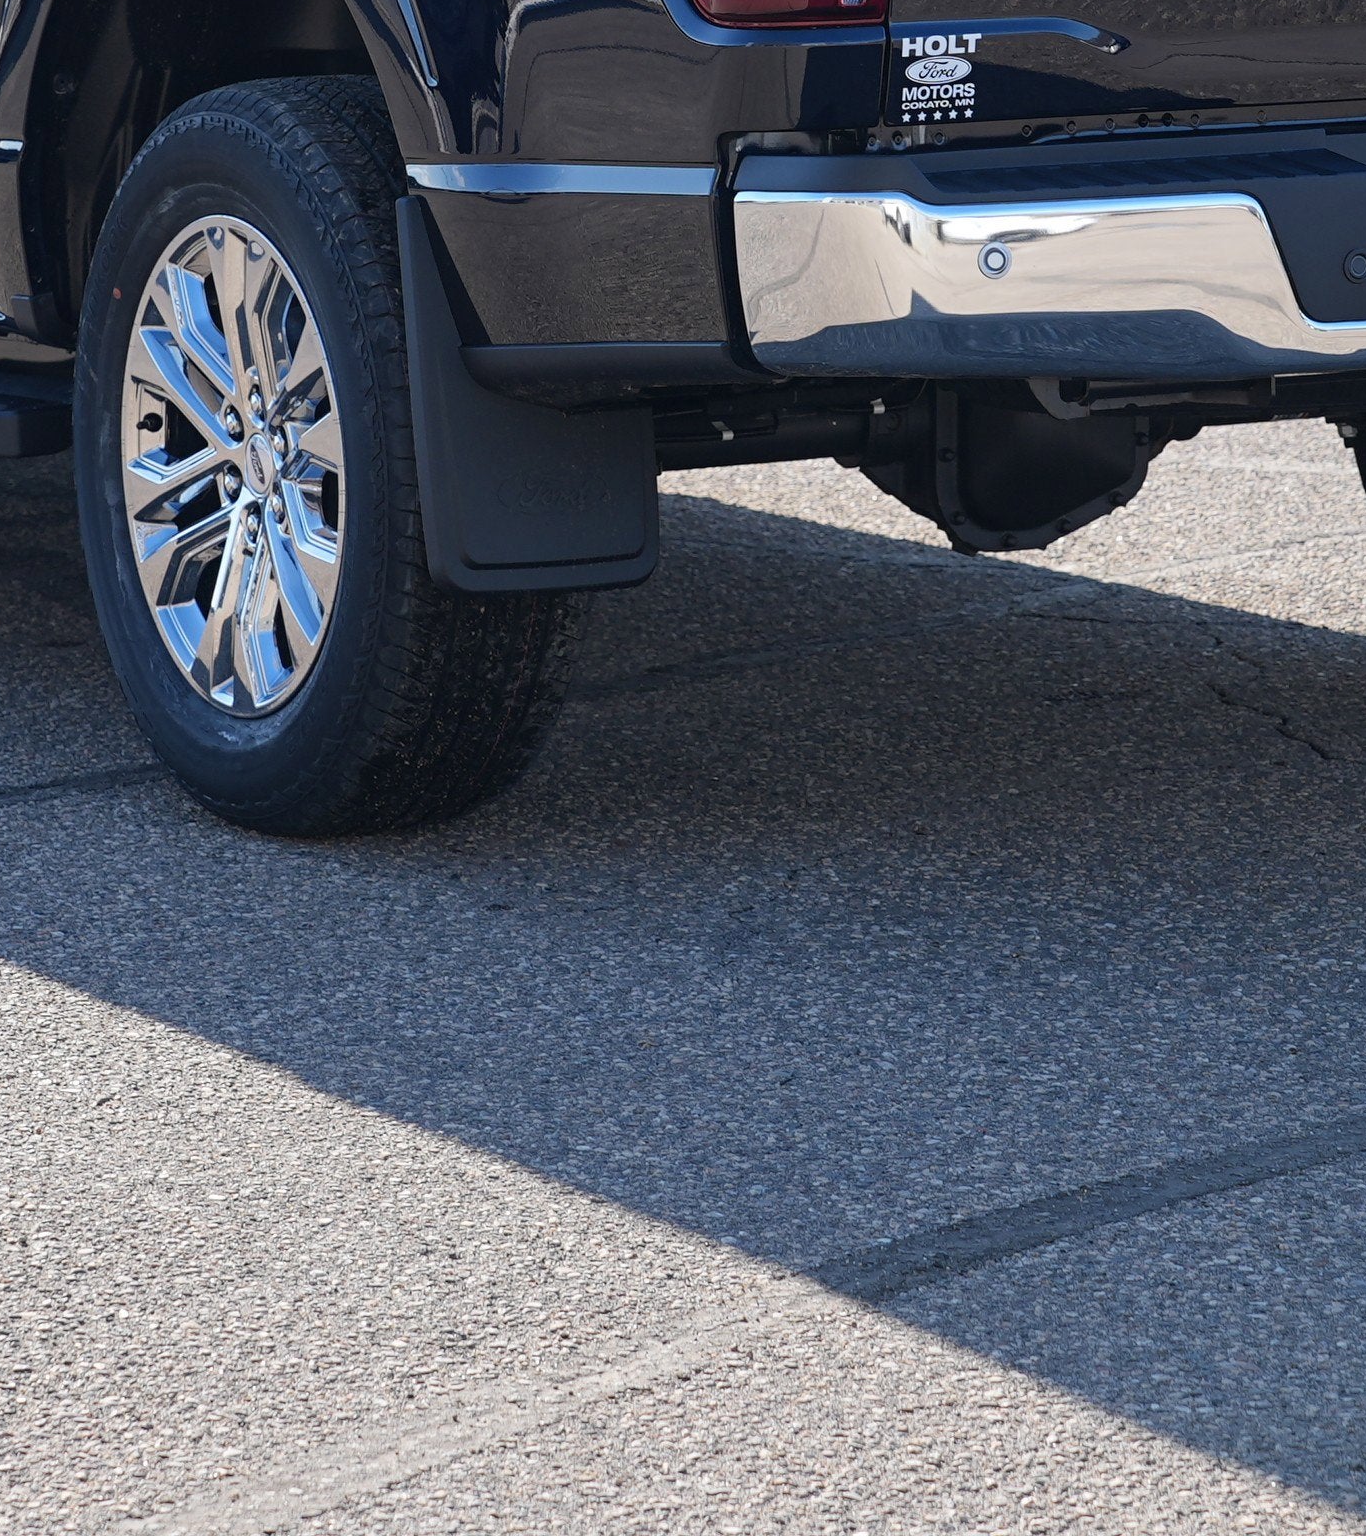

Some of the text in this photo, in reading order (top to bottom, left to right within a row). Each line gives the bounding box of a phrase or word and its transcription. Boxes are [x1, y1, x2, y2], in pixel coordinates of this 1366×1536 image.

[901, 33, 982, 57] HOLT
[918, 61, 959, 79] Ford
[901, 83, 976, 102] MOTORS
[901, 98, 975, 111] COKATO, MN
